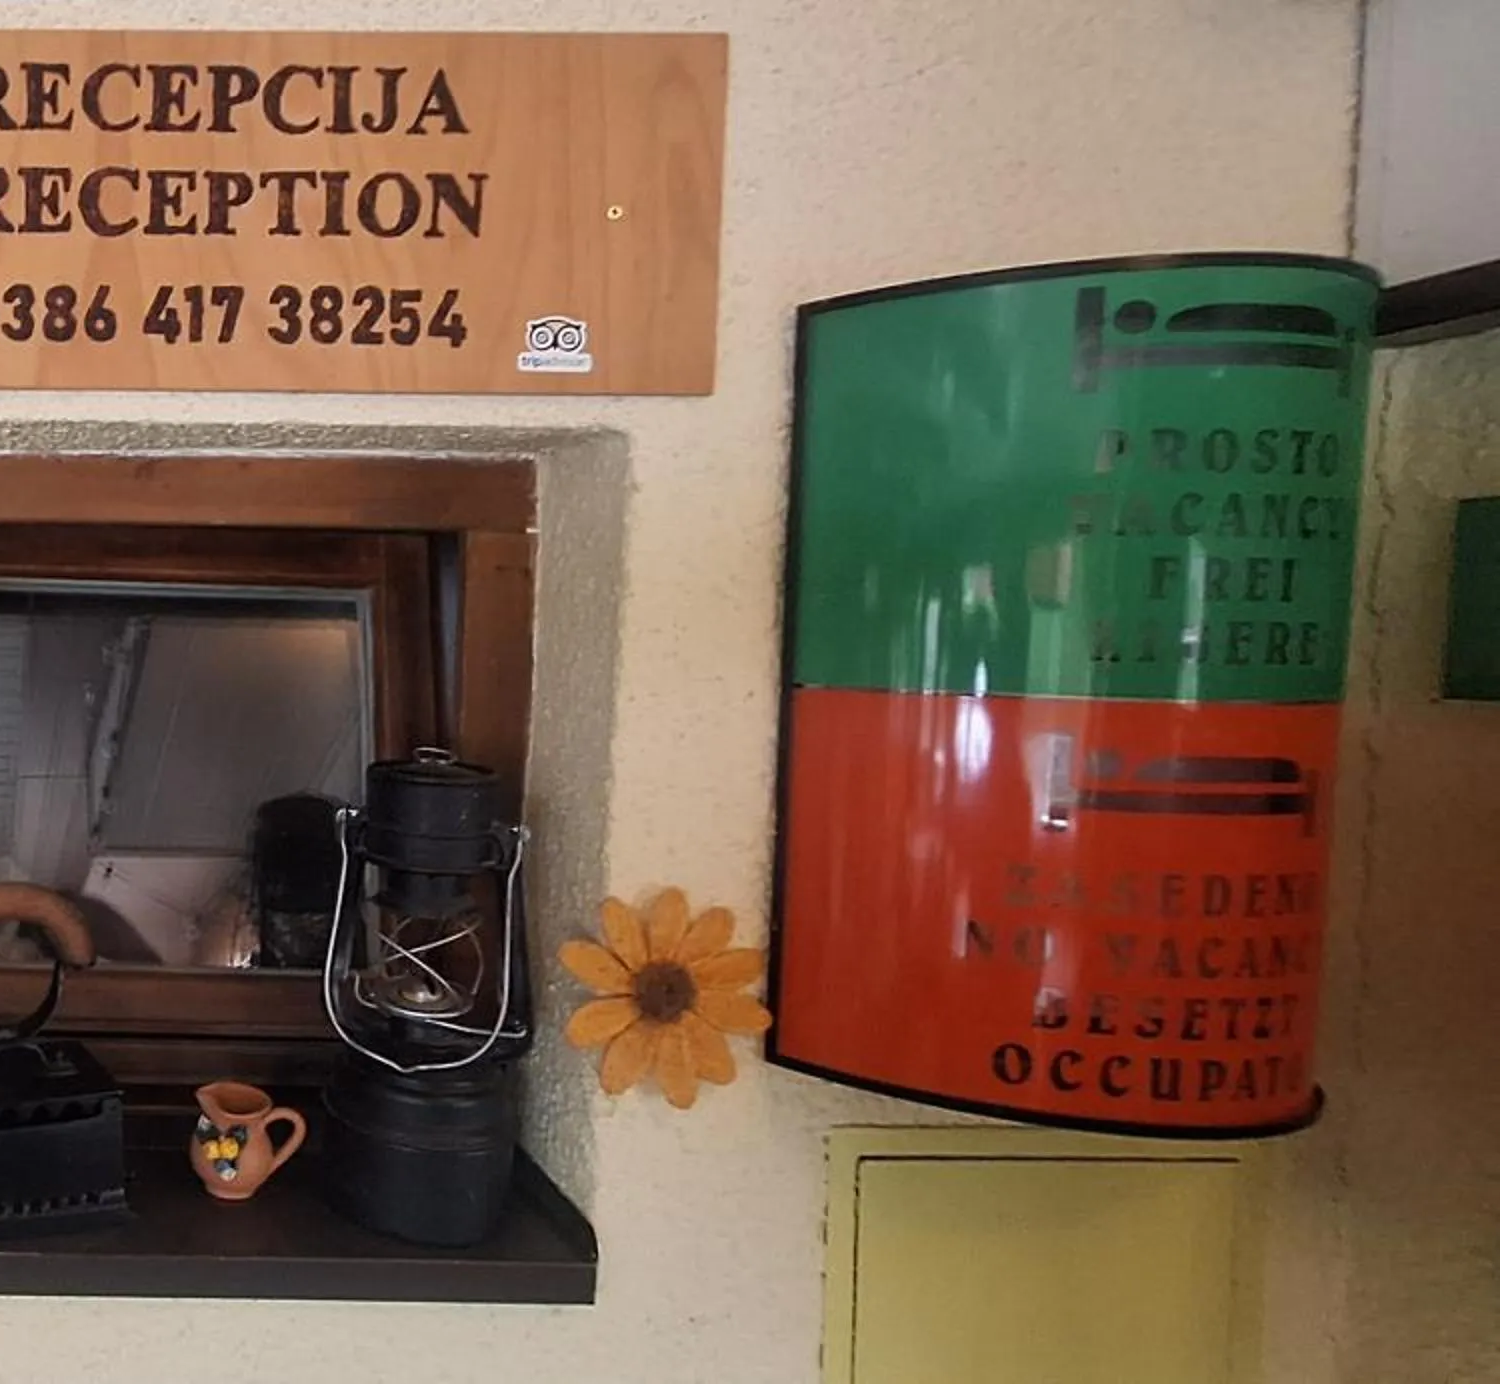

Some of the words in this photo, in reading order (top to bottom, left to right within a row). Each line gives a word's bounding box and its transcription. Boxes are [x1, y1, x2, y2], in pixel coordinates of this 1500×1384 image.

[142, 285, 246, 344] 417
[267, 284, 468, 348] 38254
[1094, 427, 1340, 478] PROSTO
[1146, 555, 1300, 604] FREI
